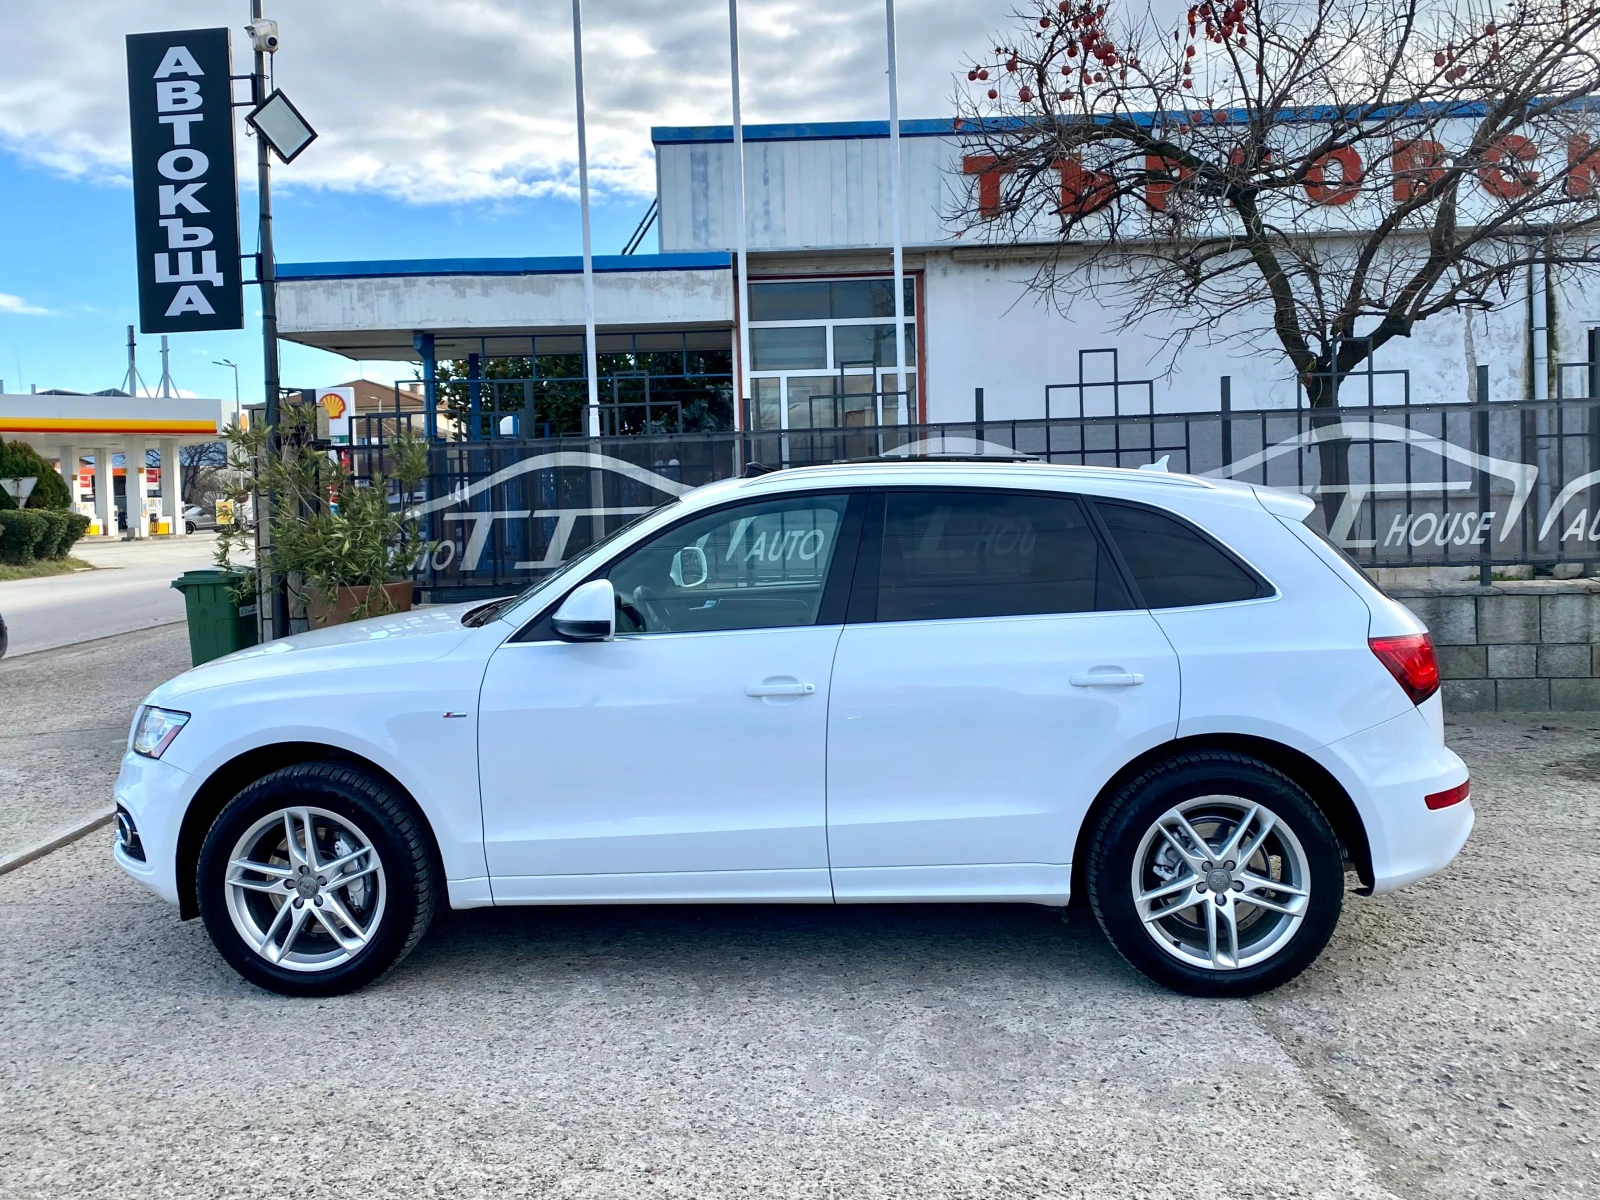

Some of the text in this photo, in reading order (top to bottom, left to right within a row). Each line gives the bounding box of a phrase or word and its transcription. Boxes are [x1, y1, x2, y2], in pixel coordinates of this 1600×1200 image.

[152, 45, 224, 317] АВТОКЪЩА
[744, 529, 825, 562] AUTO
[1383, 511, 1496, 547] HOUSE
